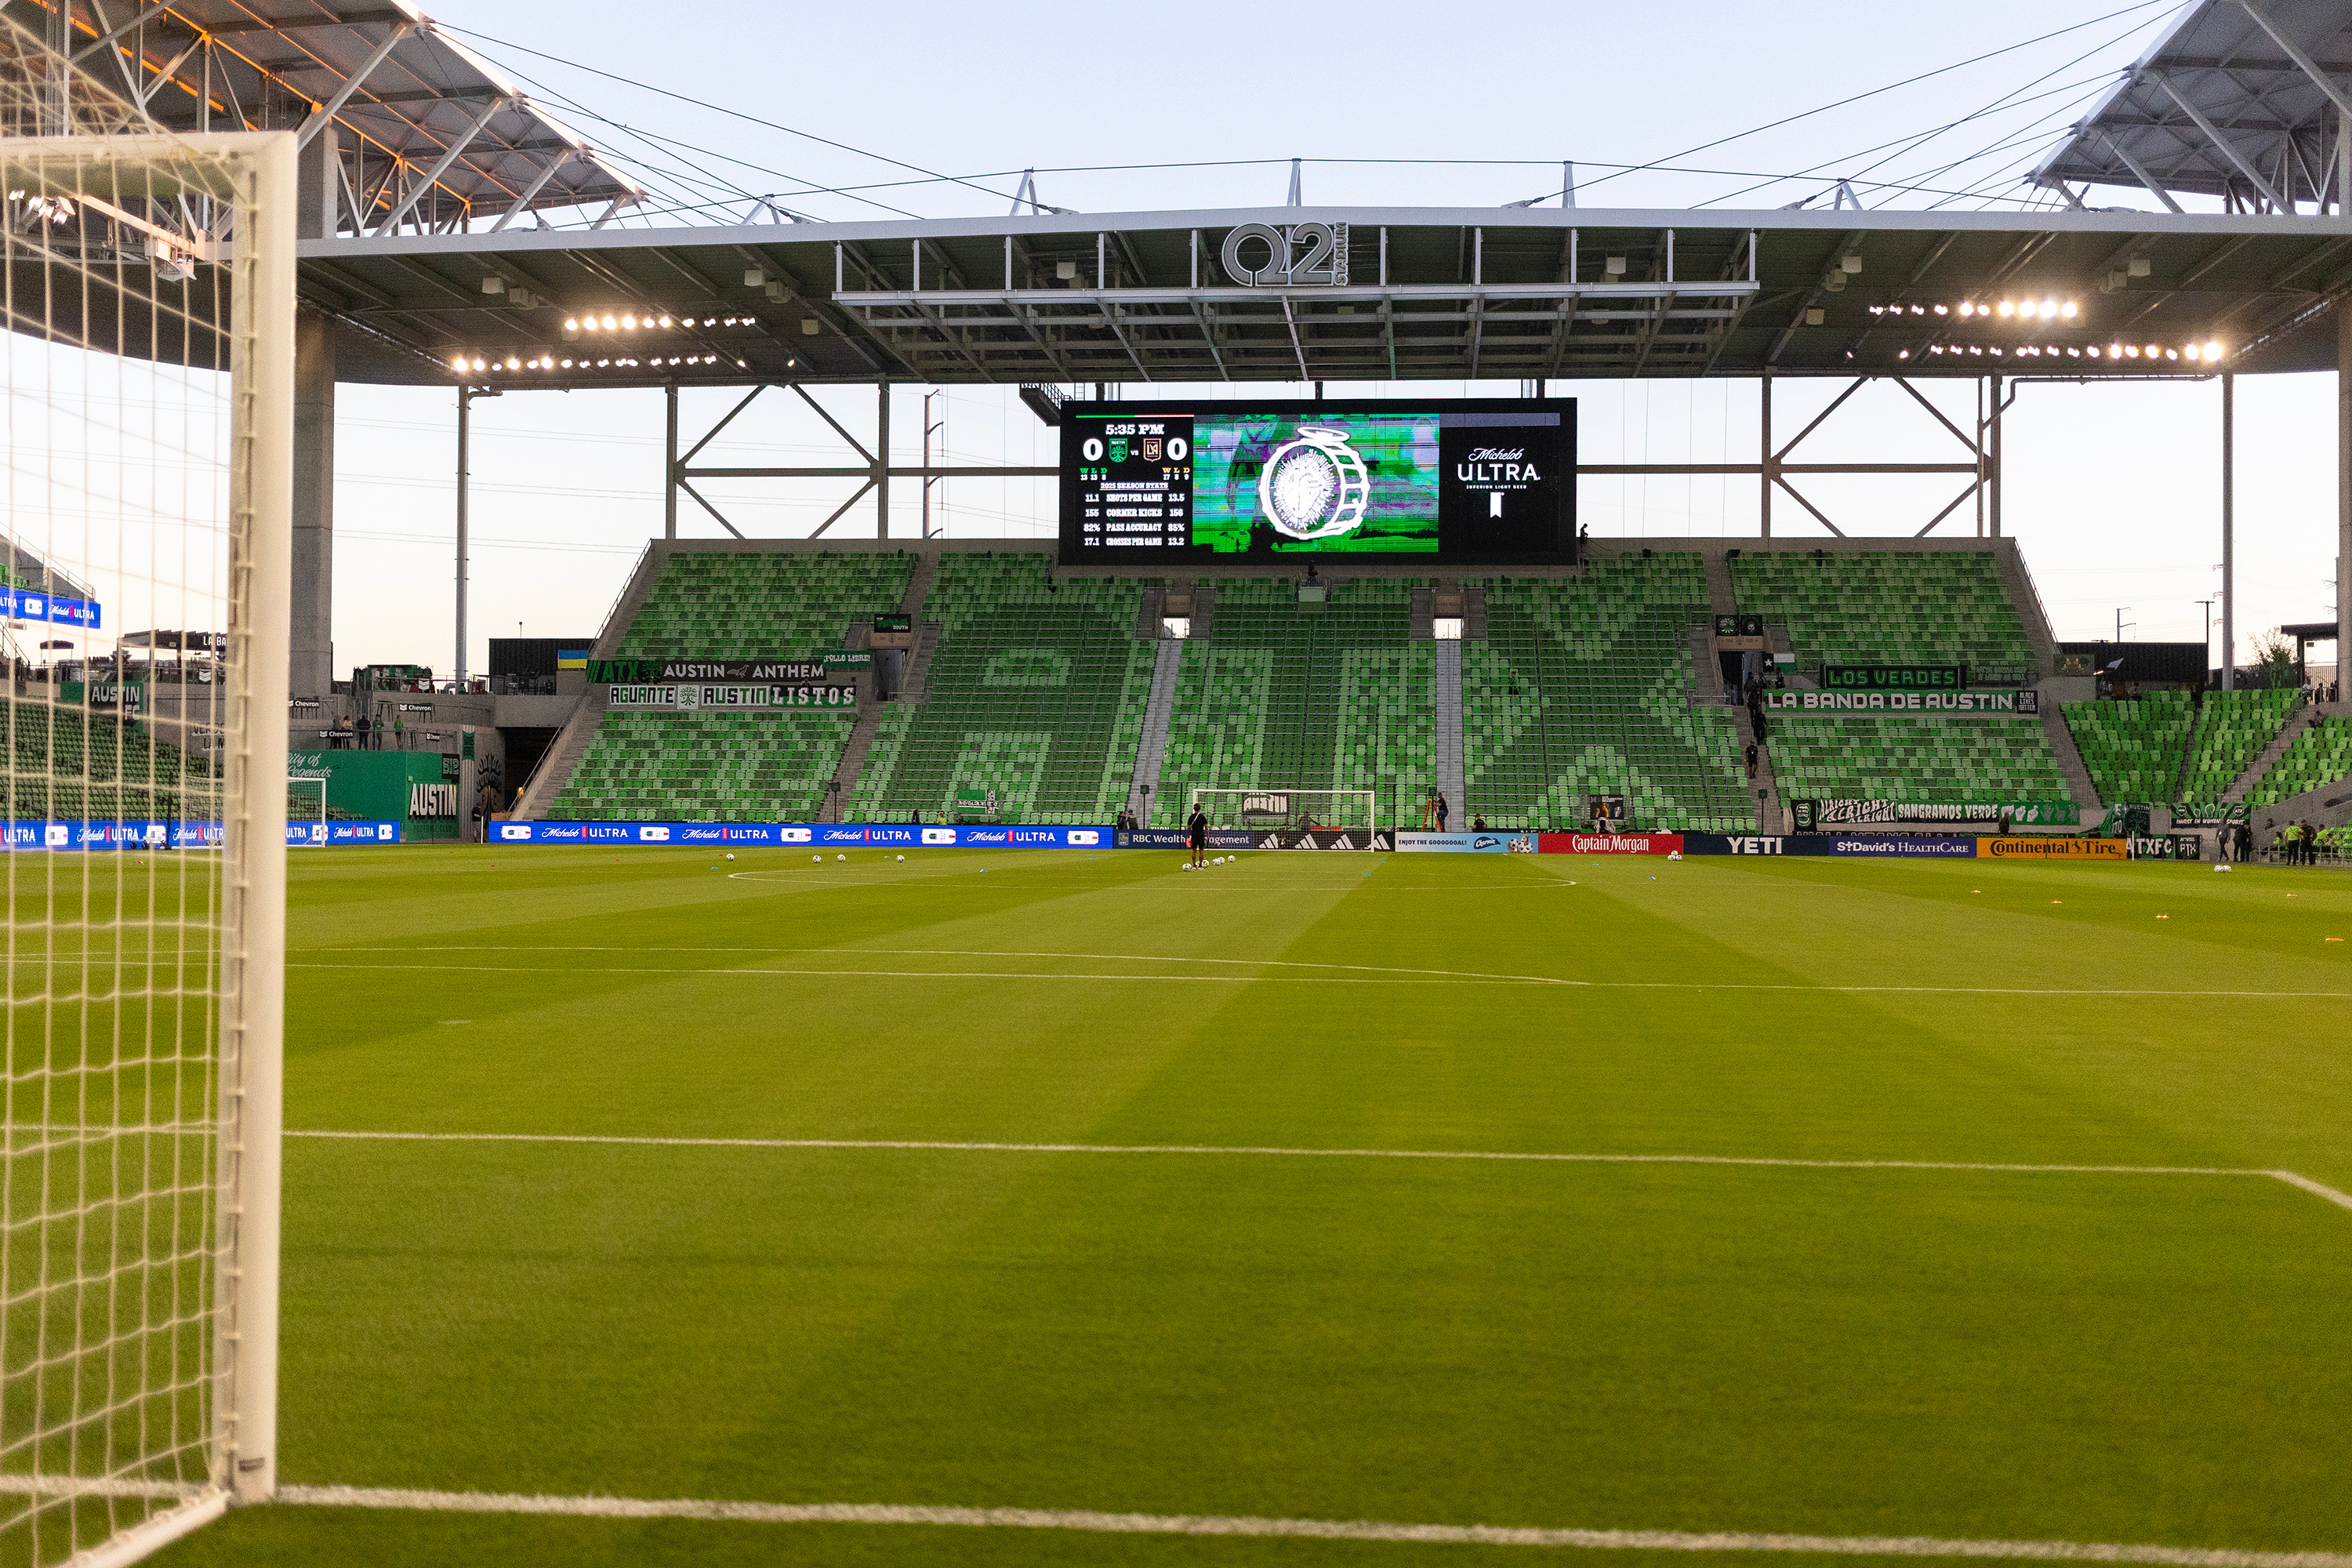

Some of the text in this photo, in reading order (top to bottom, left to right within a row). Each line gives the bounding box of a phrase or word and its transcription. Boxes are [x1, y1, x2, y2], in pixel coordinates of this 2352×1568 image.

[1221, 223, 1334, 286] Q2
[1334, 222, 1348, 286] STADIUM
[1105, 424, 1165, 435] 5:35 PM
[1083, 437, 1103, 461] 0
[1167, 437, 1188, 461] 0
[1468, 448, 1524, 461] Michelob
[1457, 463, 1538, 481] ULTRA
[74, 608, 94, 619] ULTRA
[601, 662, 824, 682] ATX AUSTIN ANTHEM
[1829, 670, 1955, 685] LOS VERDES
[91, 686, 140, 702] AUSTIN
[612, 688, 674, 703] AGUANTE
[704, 688, 766, 704] AUSTIN
[772, 687, 855, 705] LISTOS
[1768, 693, 2013, 710] LA BANDA DE AUSTIN
[308, 753, 323, 768] of
[443, 758, 459, 774] 512
[409, 783, 457, 816] AUSTIN
[1243, 793, 1287, 813] AUSTIN
[1847, 801, 1895, 823] ALRIGHT
[1898, 804, 1998, 819] SANGRAMOS VERDE
[4, 829, 35, 843] ULTRA
[111, 828, 139, 841] ULTRA
[285, 827, 307, 838] ULTRA
[357, 827, 375, 838] ULTRA
[541, 828, 628, 838] Michelob ULTRA
[682, 829, 769, 840] Michelob ULTRA
[823, 830, 912, 840] Michelob ULTRA
[967, 831, 1056, 842] Michelob ULTRA
[1153, 834, 1186, 843] Wealth
[1475, 840, 1496, 848] Charmin
[1572, 835, 1649, 853] Captain Morgan
[1727, 837, 1783, 854] YETI
[1990, 840, 2117, 856] Continental Tire
